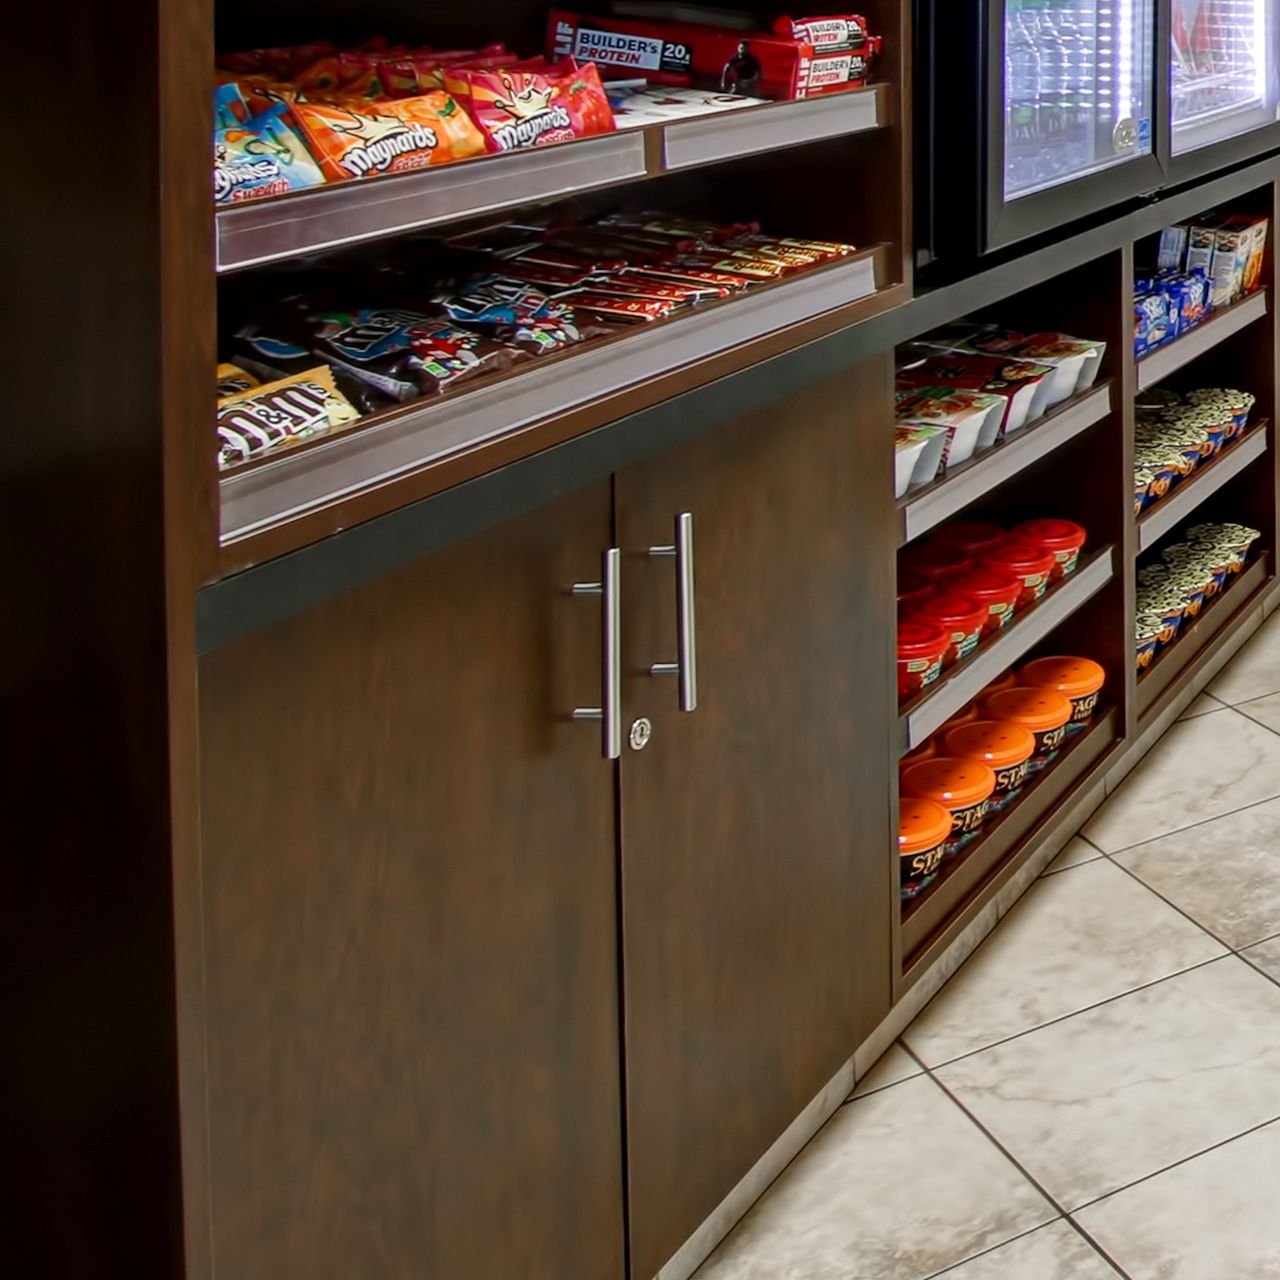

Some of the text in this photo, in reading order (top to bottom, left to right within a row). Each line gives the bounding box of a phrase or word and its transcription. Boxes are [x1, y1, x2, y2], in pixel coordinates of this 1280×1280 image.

[577, 47, 641, 65] PROTEIN
[338, 122, 438, 176] Maynards
[493, 105, 571, 151] Maynards
